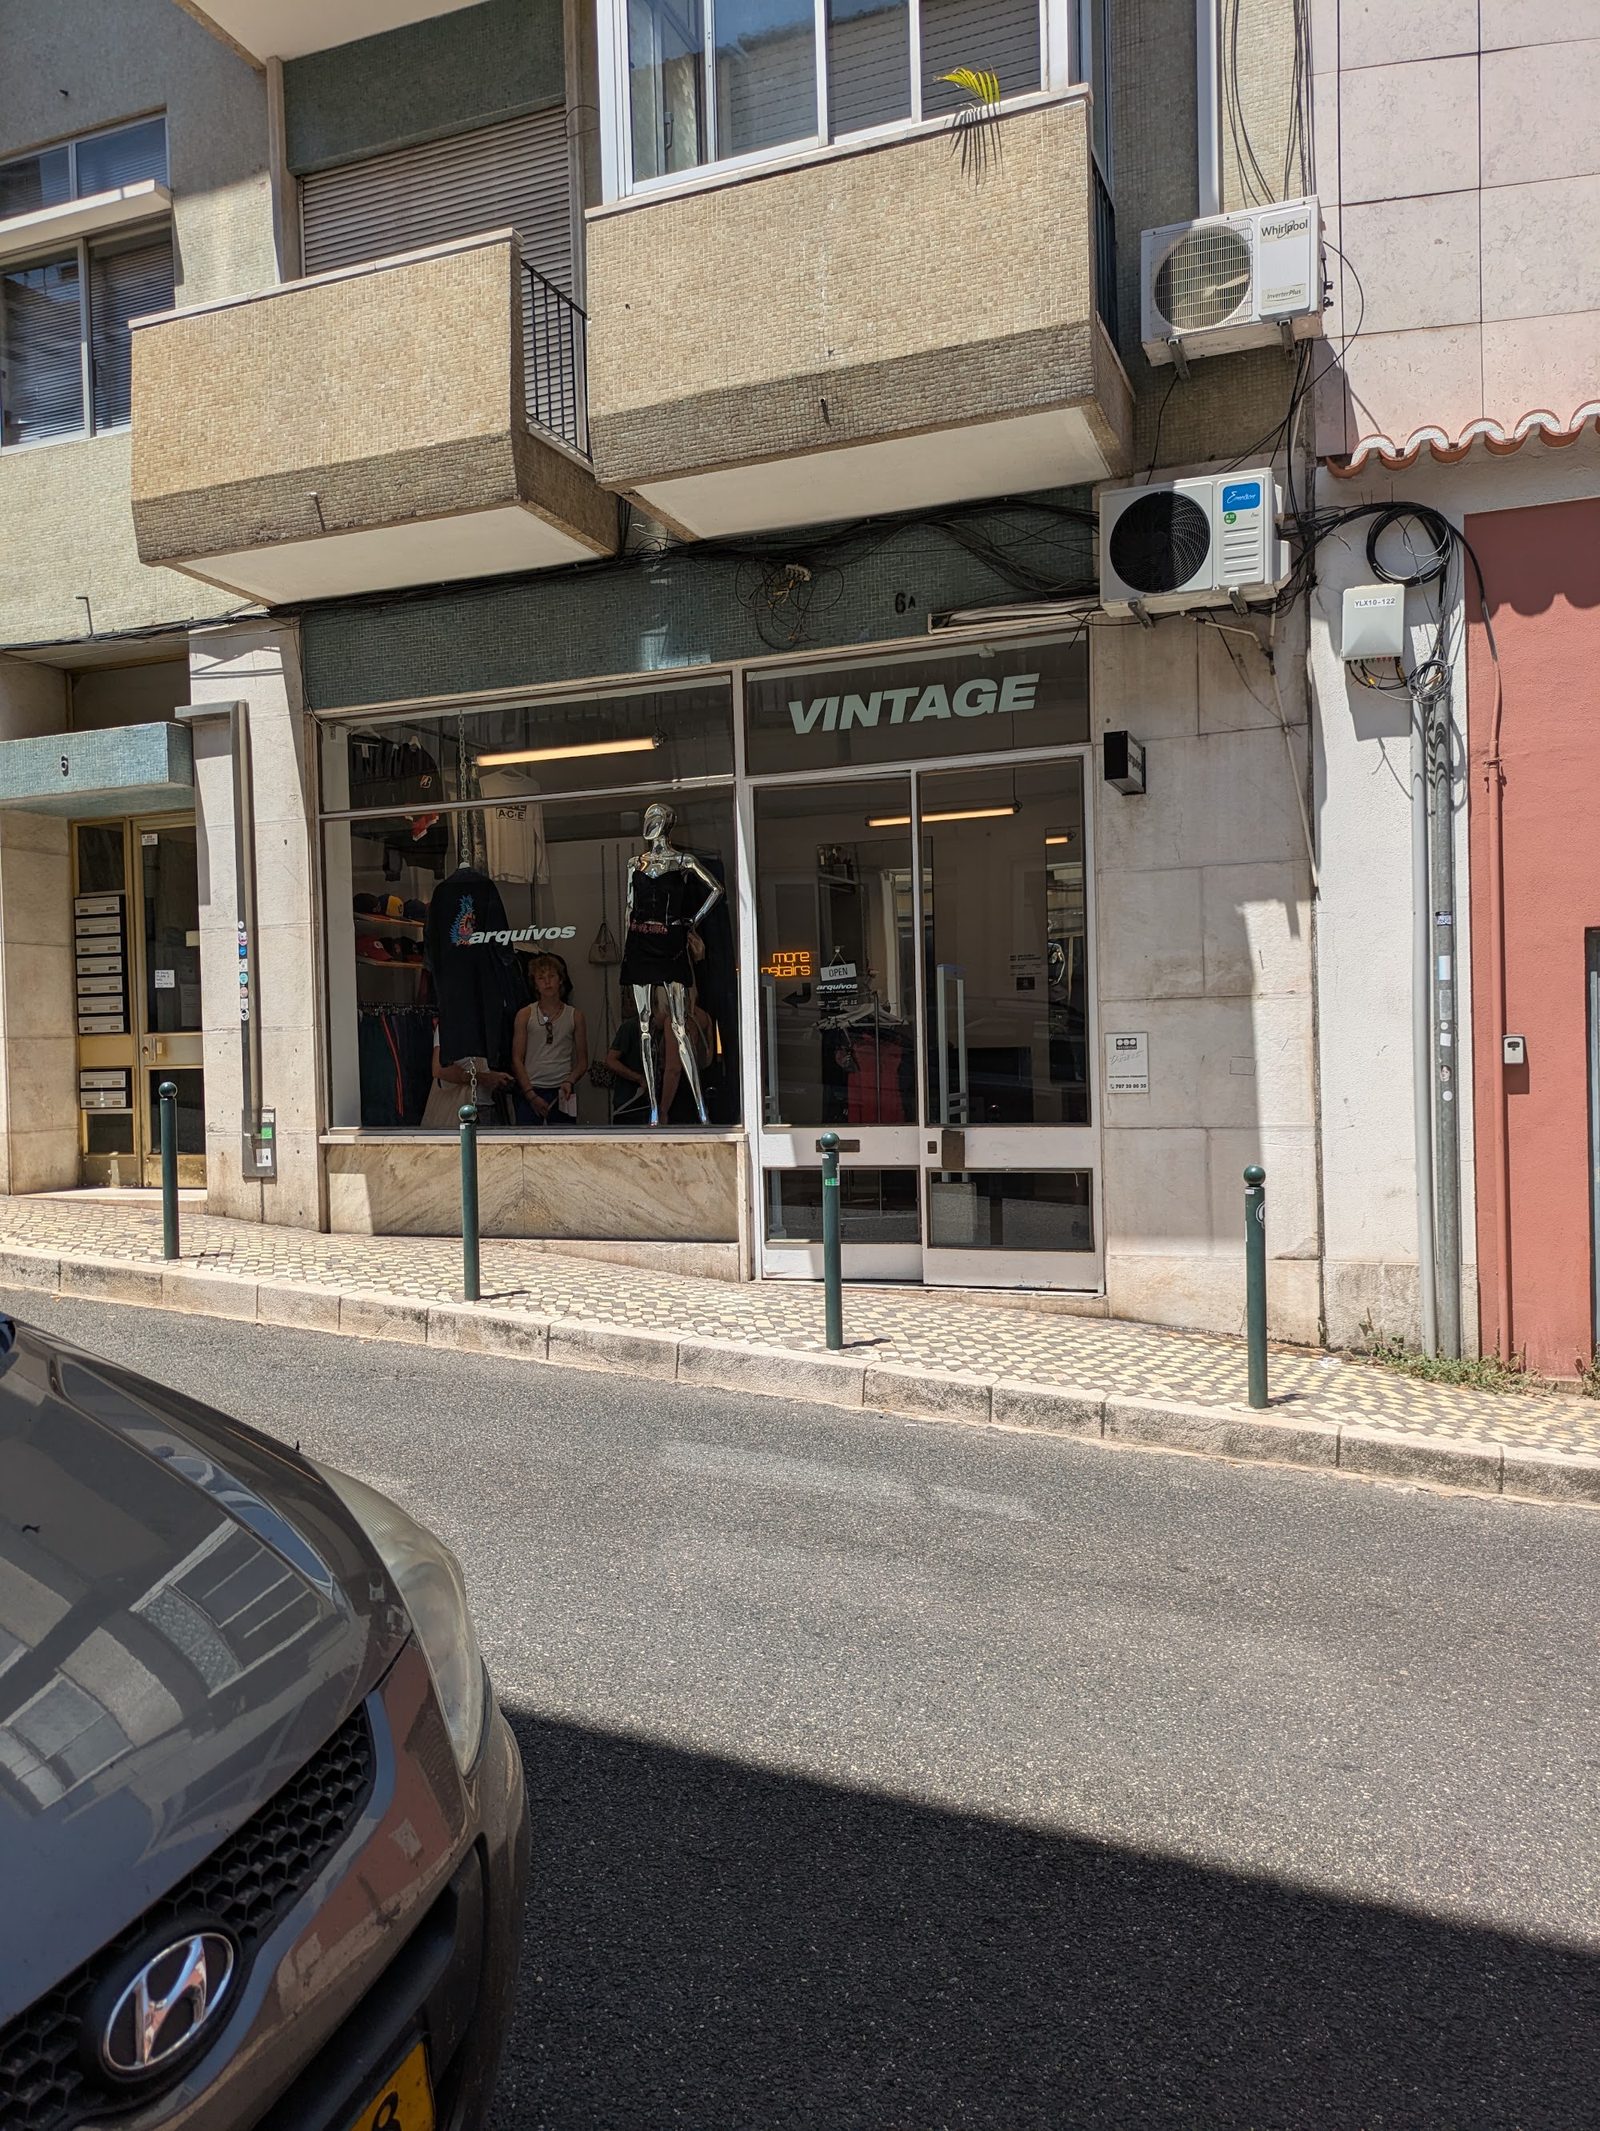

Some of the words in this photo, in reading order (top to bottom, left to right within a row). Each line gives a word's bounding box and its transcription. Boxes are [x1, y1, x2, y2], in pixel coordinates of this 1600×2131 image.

[1261, 218, 1308, 238] Whirlpool
[1354, 598, 1395, 607] YLX10-122
[788, 673, 1040, 735] VINTAGE
[772, 951, 810, 963] more
[828, 967, 848, 978] OPEN
